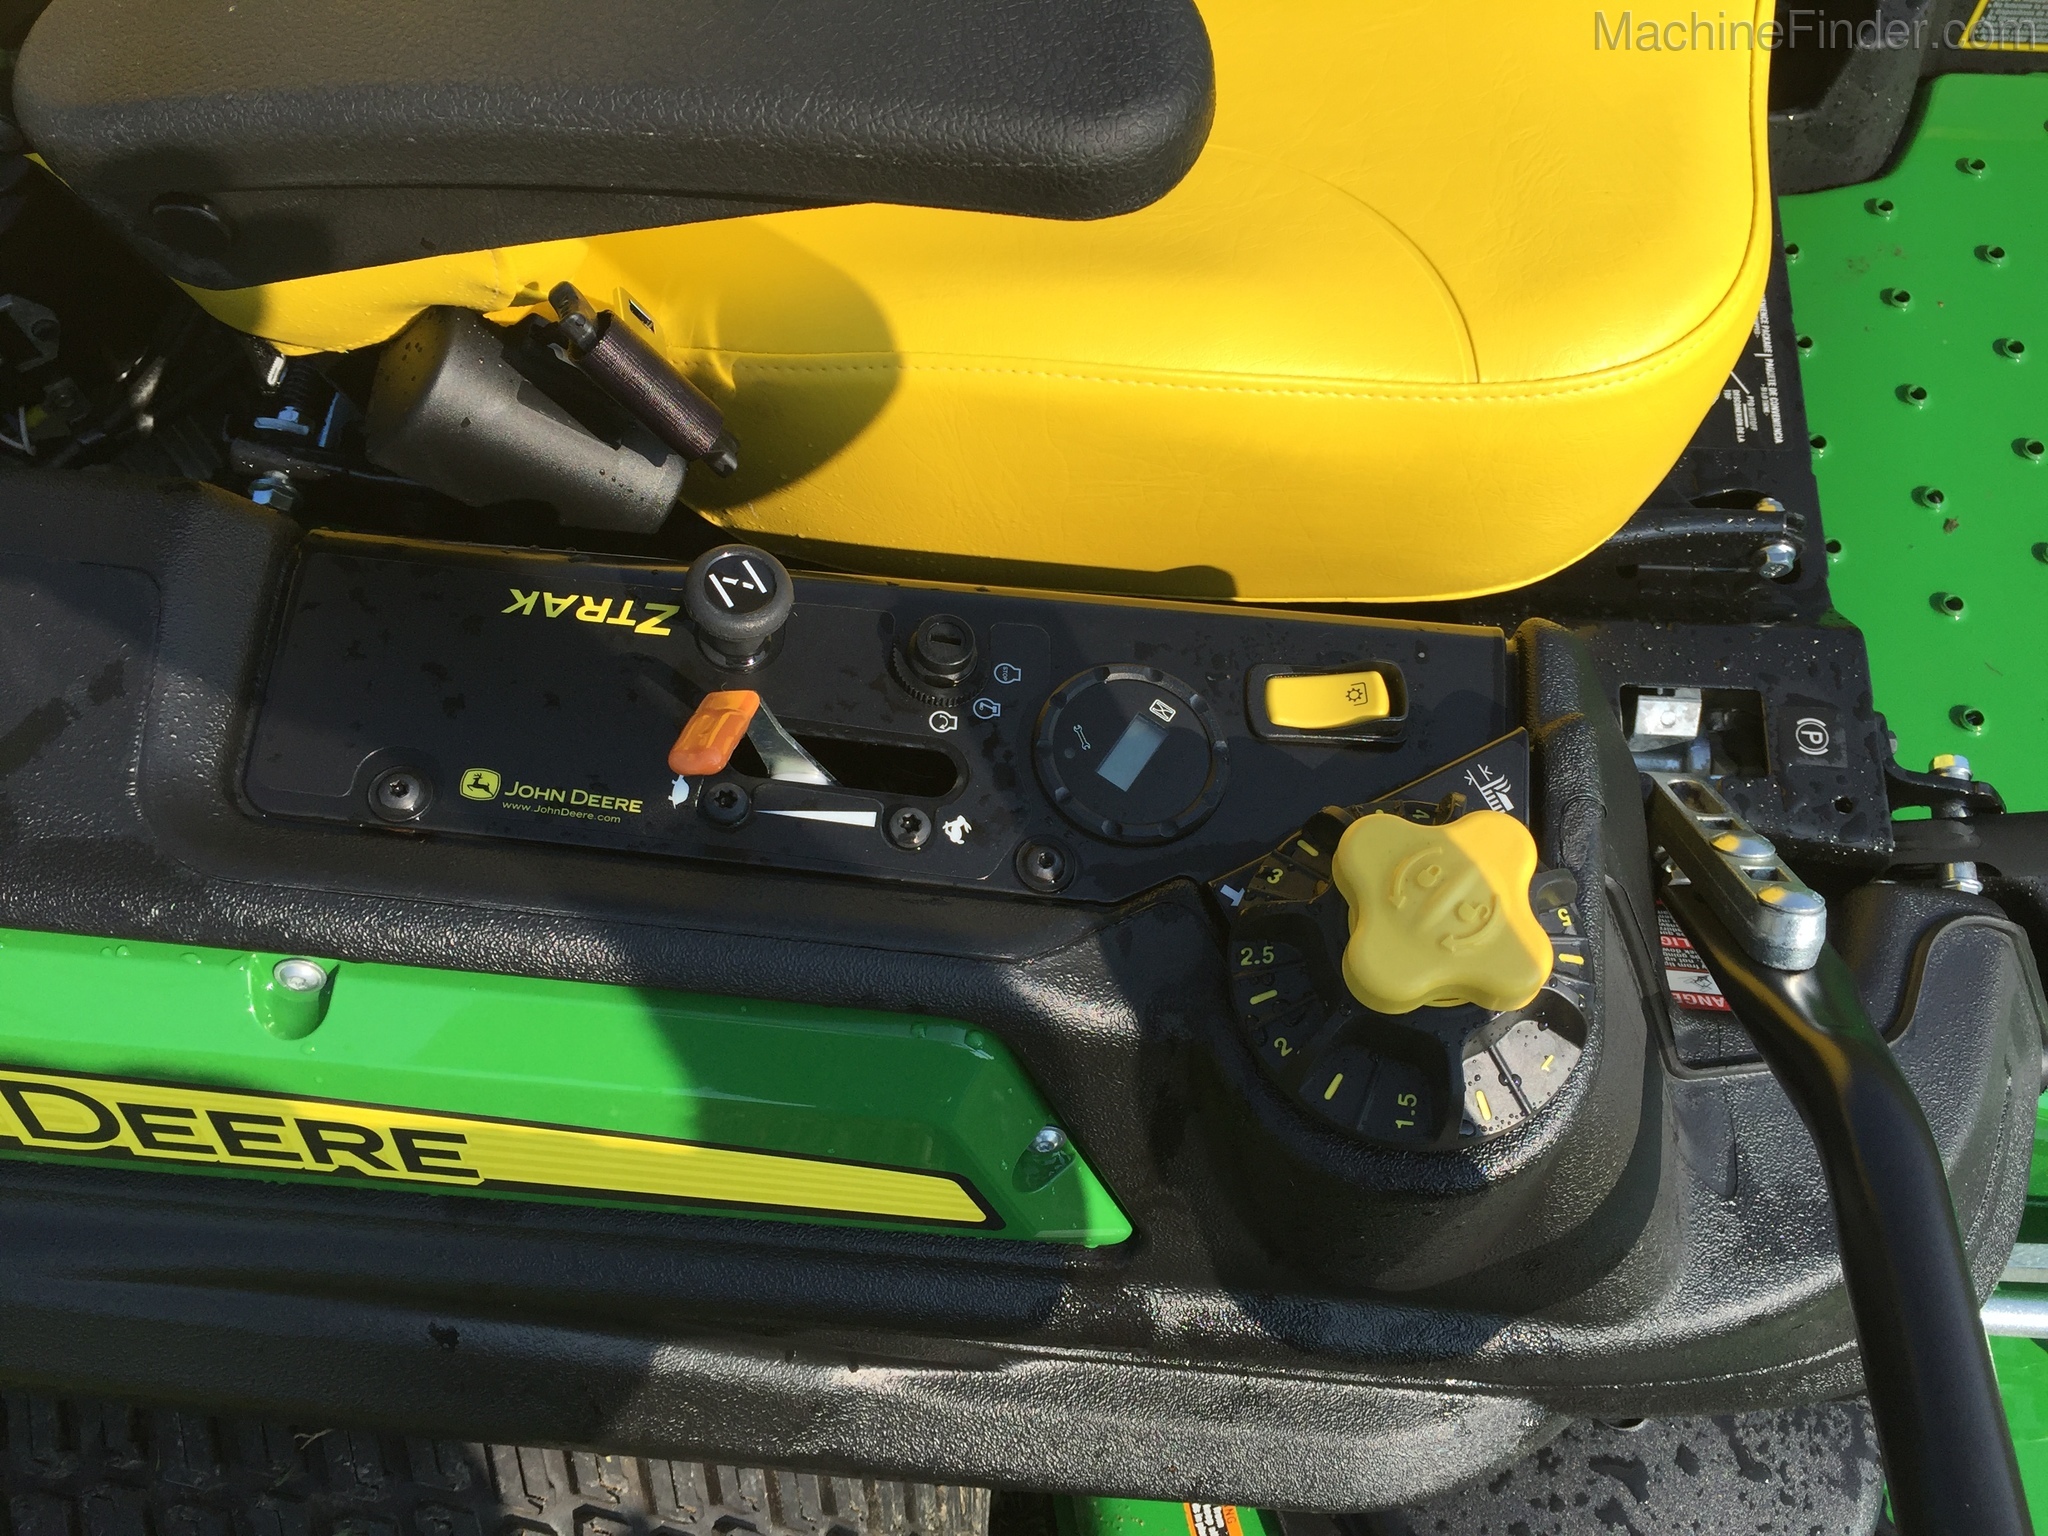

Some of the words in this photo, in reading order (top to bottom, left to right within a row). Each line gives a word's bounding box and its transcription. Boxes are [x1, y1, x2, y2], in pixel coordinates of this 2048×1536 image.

[1765, 358, 1777, 387] PAQUETE
[1748, 408, 1758, 431] SHUTOFF
[1770, 397, 1784, 444] CONVENIENCIA
[502, 588, 681, 636] ZTRAK
[504, 781, 567, 804] JOHN
[570, 789, 644, 814] DEERE
[502, 801, 621, 824] www.JohnDeere.com
[1266, 868, 1284, 884] 3
[1240, 945, 1275, 966] 2.5
[1672, 992, 1725, 1008] ANGE
[1273, 1036, 1293, 1057] 2
[1395, 1092, 1418, 1129] 1.5
[0, 1081, 482, 1179] DEERE
